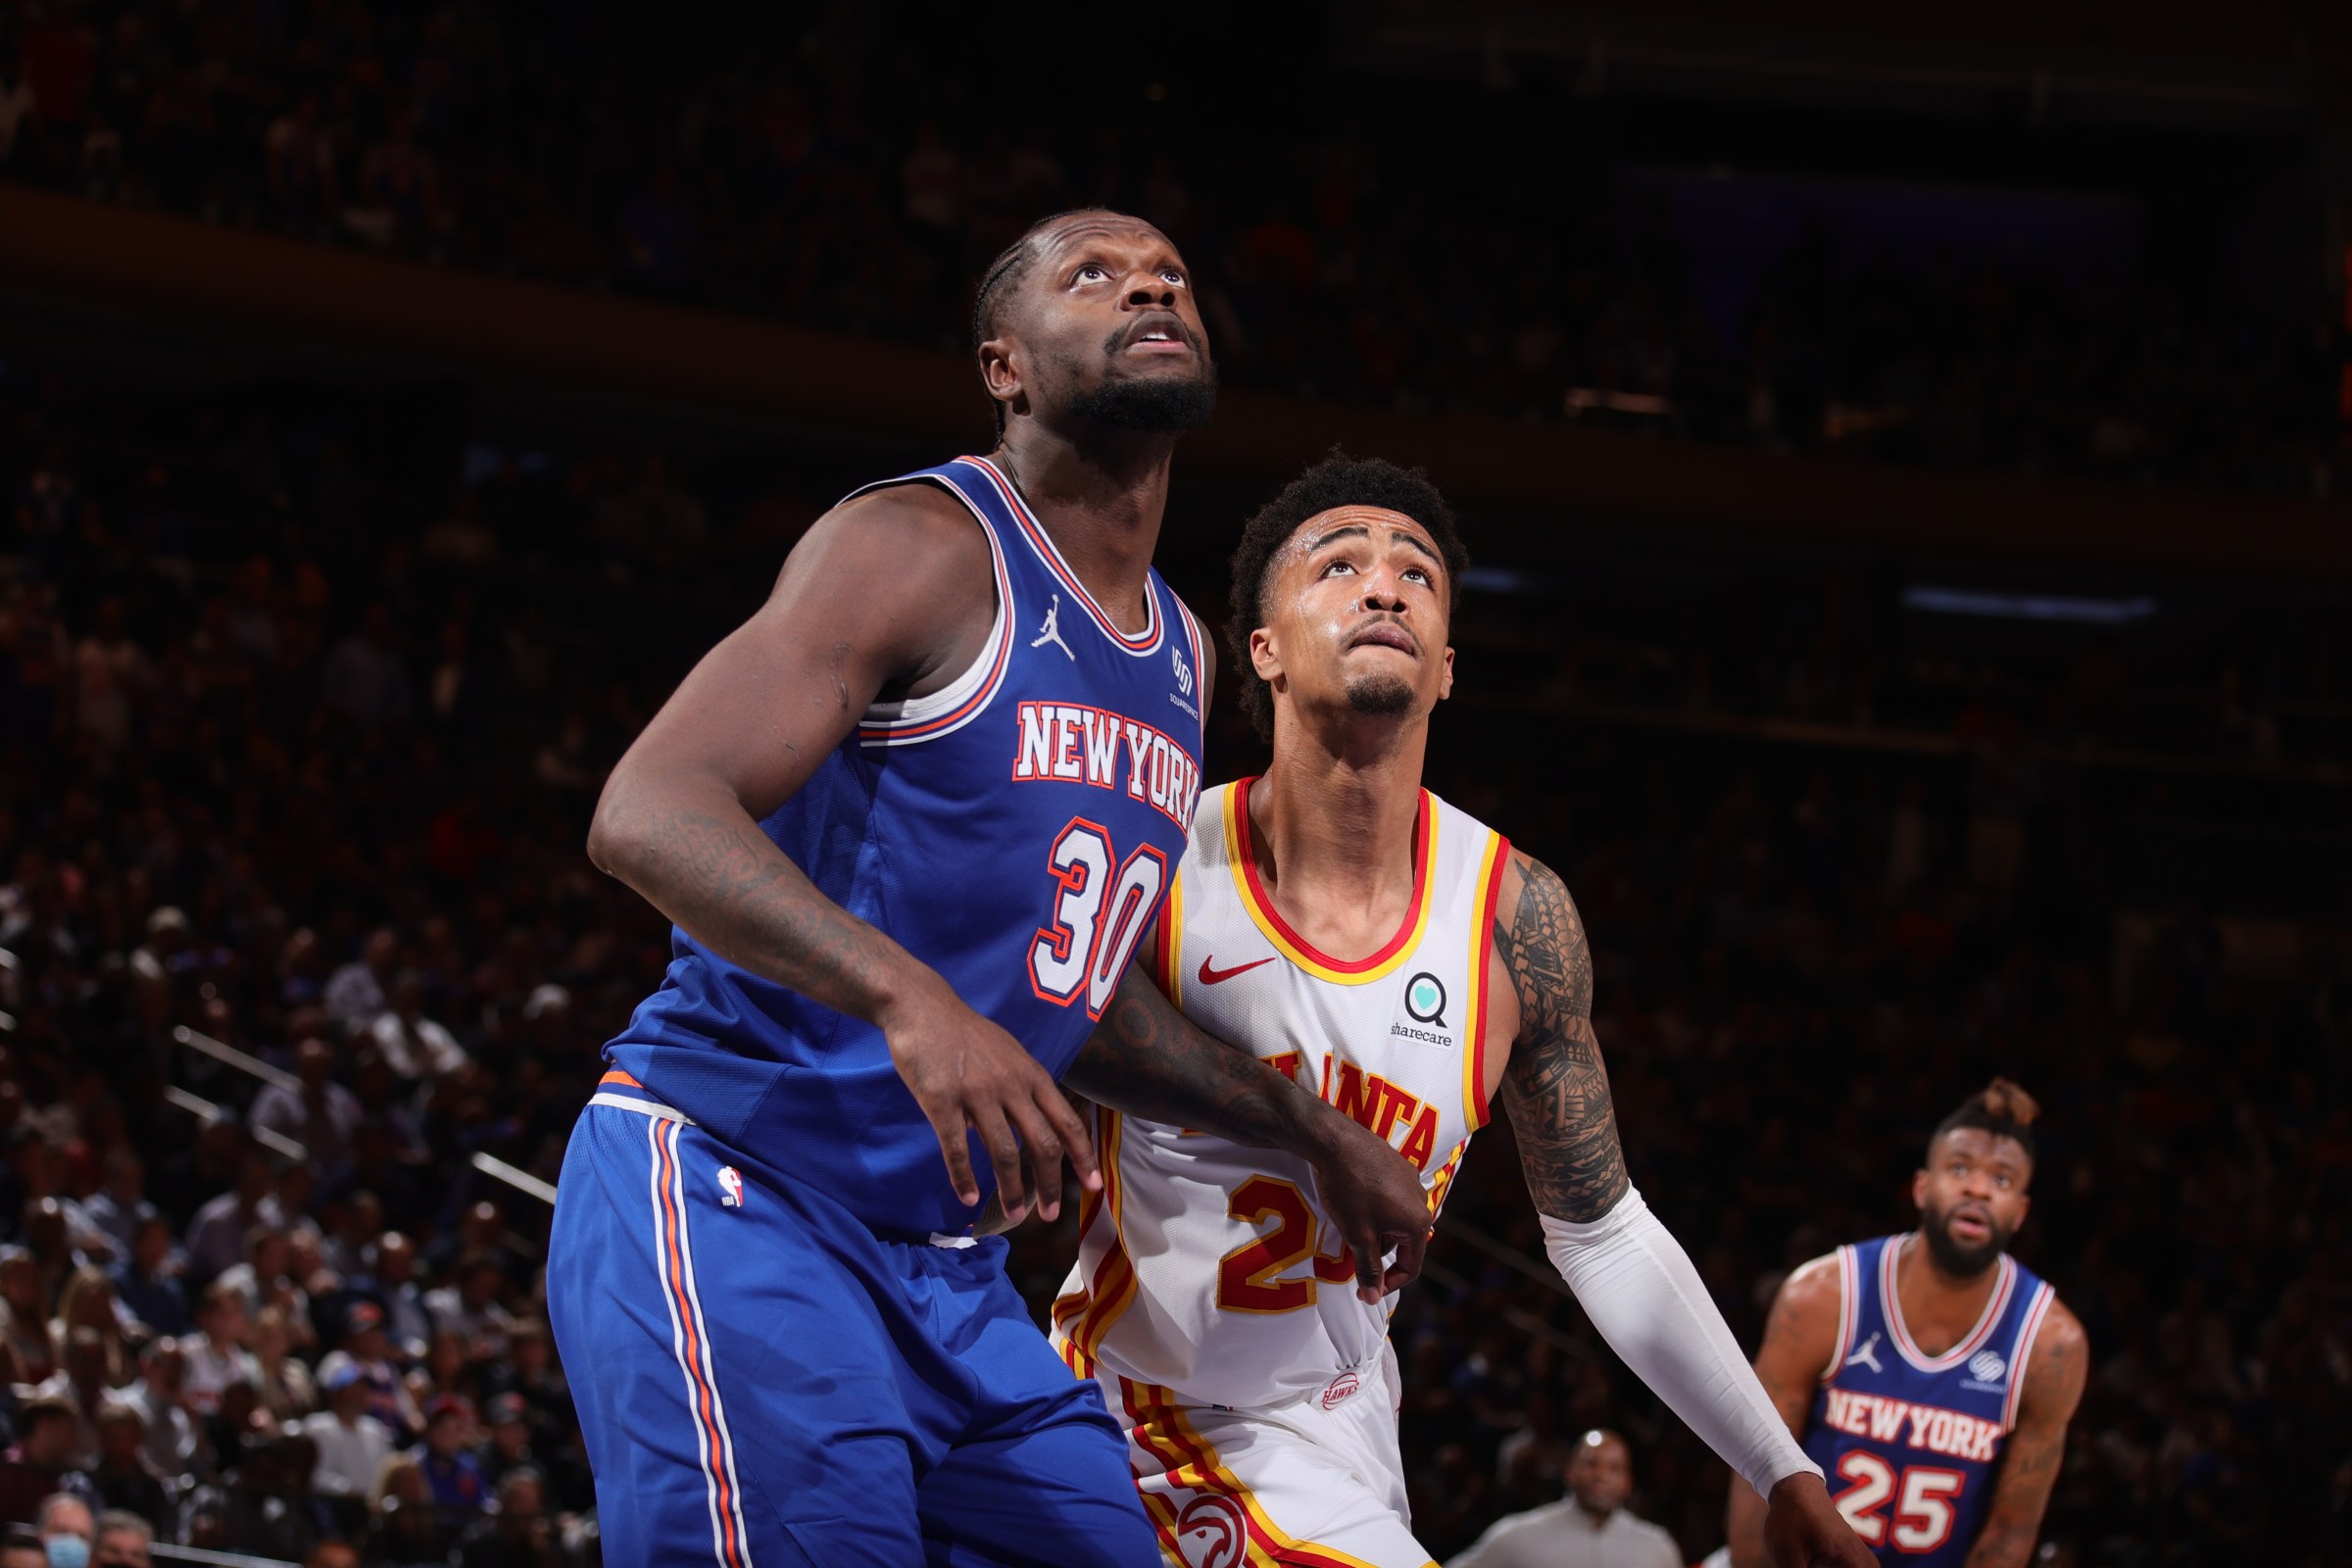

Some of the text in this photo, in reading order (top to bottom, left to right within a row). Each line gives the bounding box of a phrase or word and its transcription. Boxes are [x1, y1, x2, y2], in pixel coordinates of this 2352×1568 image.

[1012, 702, 1200, 835] NEW YORK
[1027, 816, 1167, 1022] 30
[1391, 1022, 1452, 1047] sharecare
[721, 1196, 735, 1206] NBA
[1321, 1382, 1359, 1403] HAWKS
[1825, 1388, 2004, 1463] NEW YORK
[1832, 1448, 1966, 1554] 25
